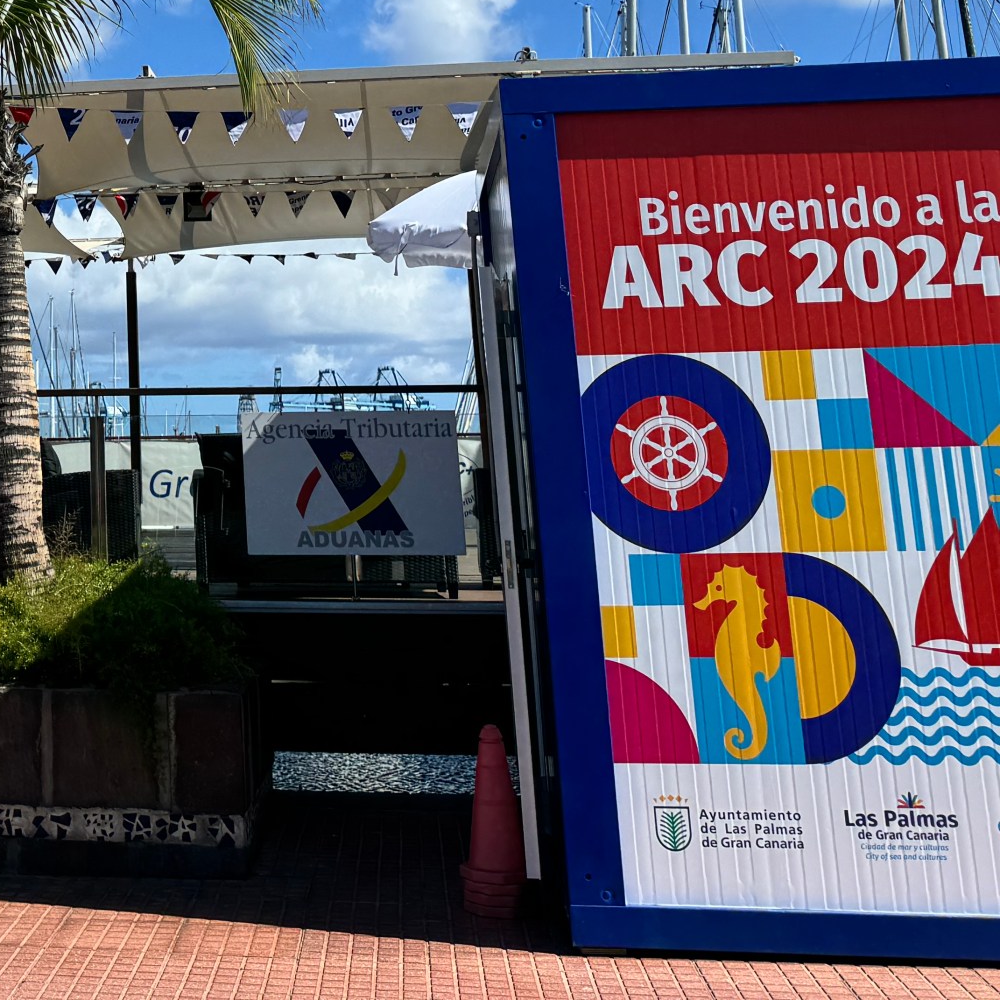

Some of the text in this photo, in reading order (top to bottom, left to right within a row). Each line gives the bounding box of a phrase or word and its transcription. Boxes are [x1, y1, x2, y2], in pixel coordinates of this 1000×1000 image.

[639, 180, 1000, 236] Bienvenido a la
[602, 232, 1000, 310] ARC 2024
[246, 418, 452, 444] Agencia Tributaria
[149, 469, 188, 498] Gr
[297, 531, 415, 548] ADUANAS
[699, 809, 801, 822] Ayuntamiento
[843, 809, 959, 828] Las Palmas
[700, 822, 803, 835] de Las Palmas
[858, 829, 949, 841] de Gran Canaria
[702, 836, 804, 849] de Gran Canaria
[887, 843, 897, 851] de
[919, 843, 949, 851] culturas
[866, 852, 878, 861] City
[881, 852, 888, 862] of
[904, 852, 917, 861] and
[919, 853, 947, 861] cultures
